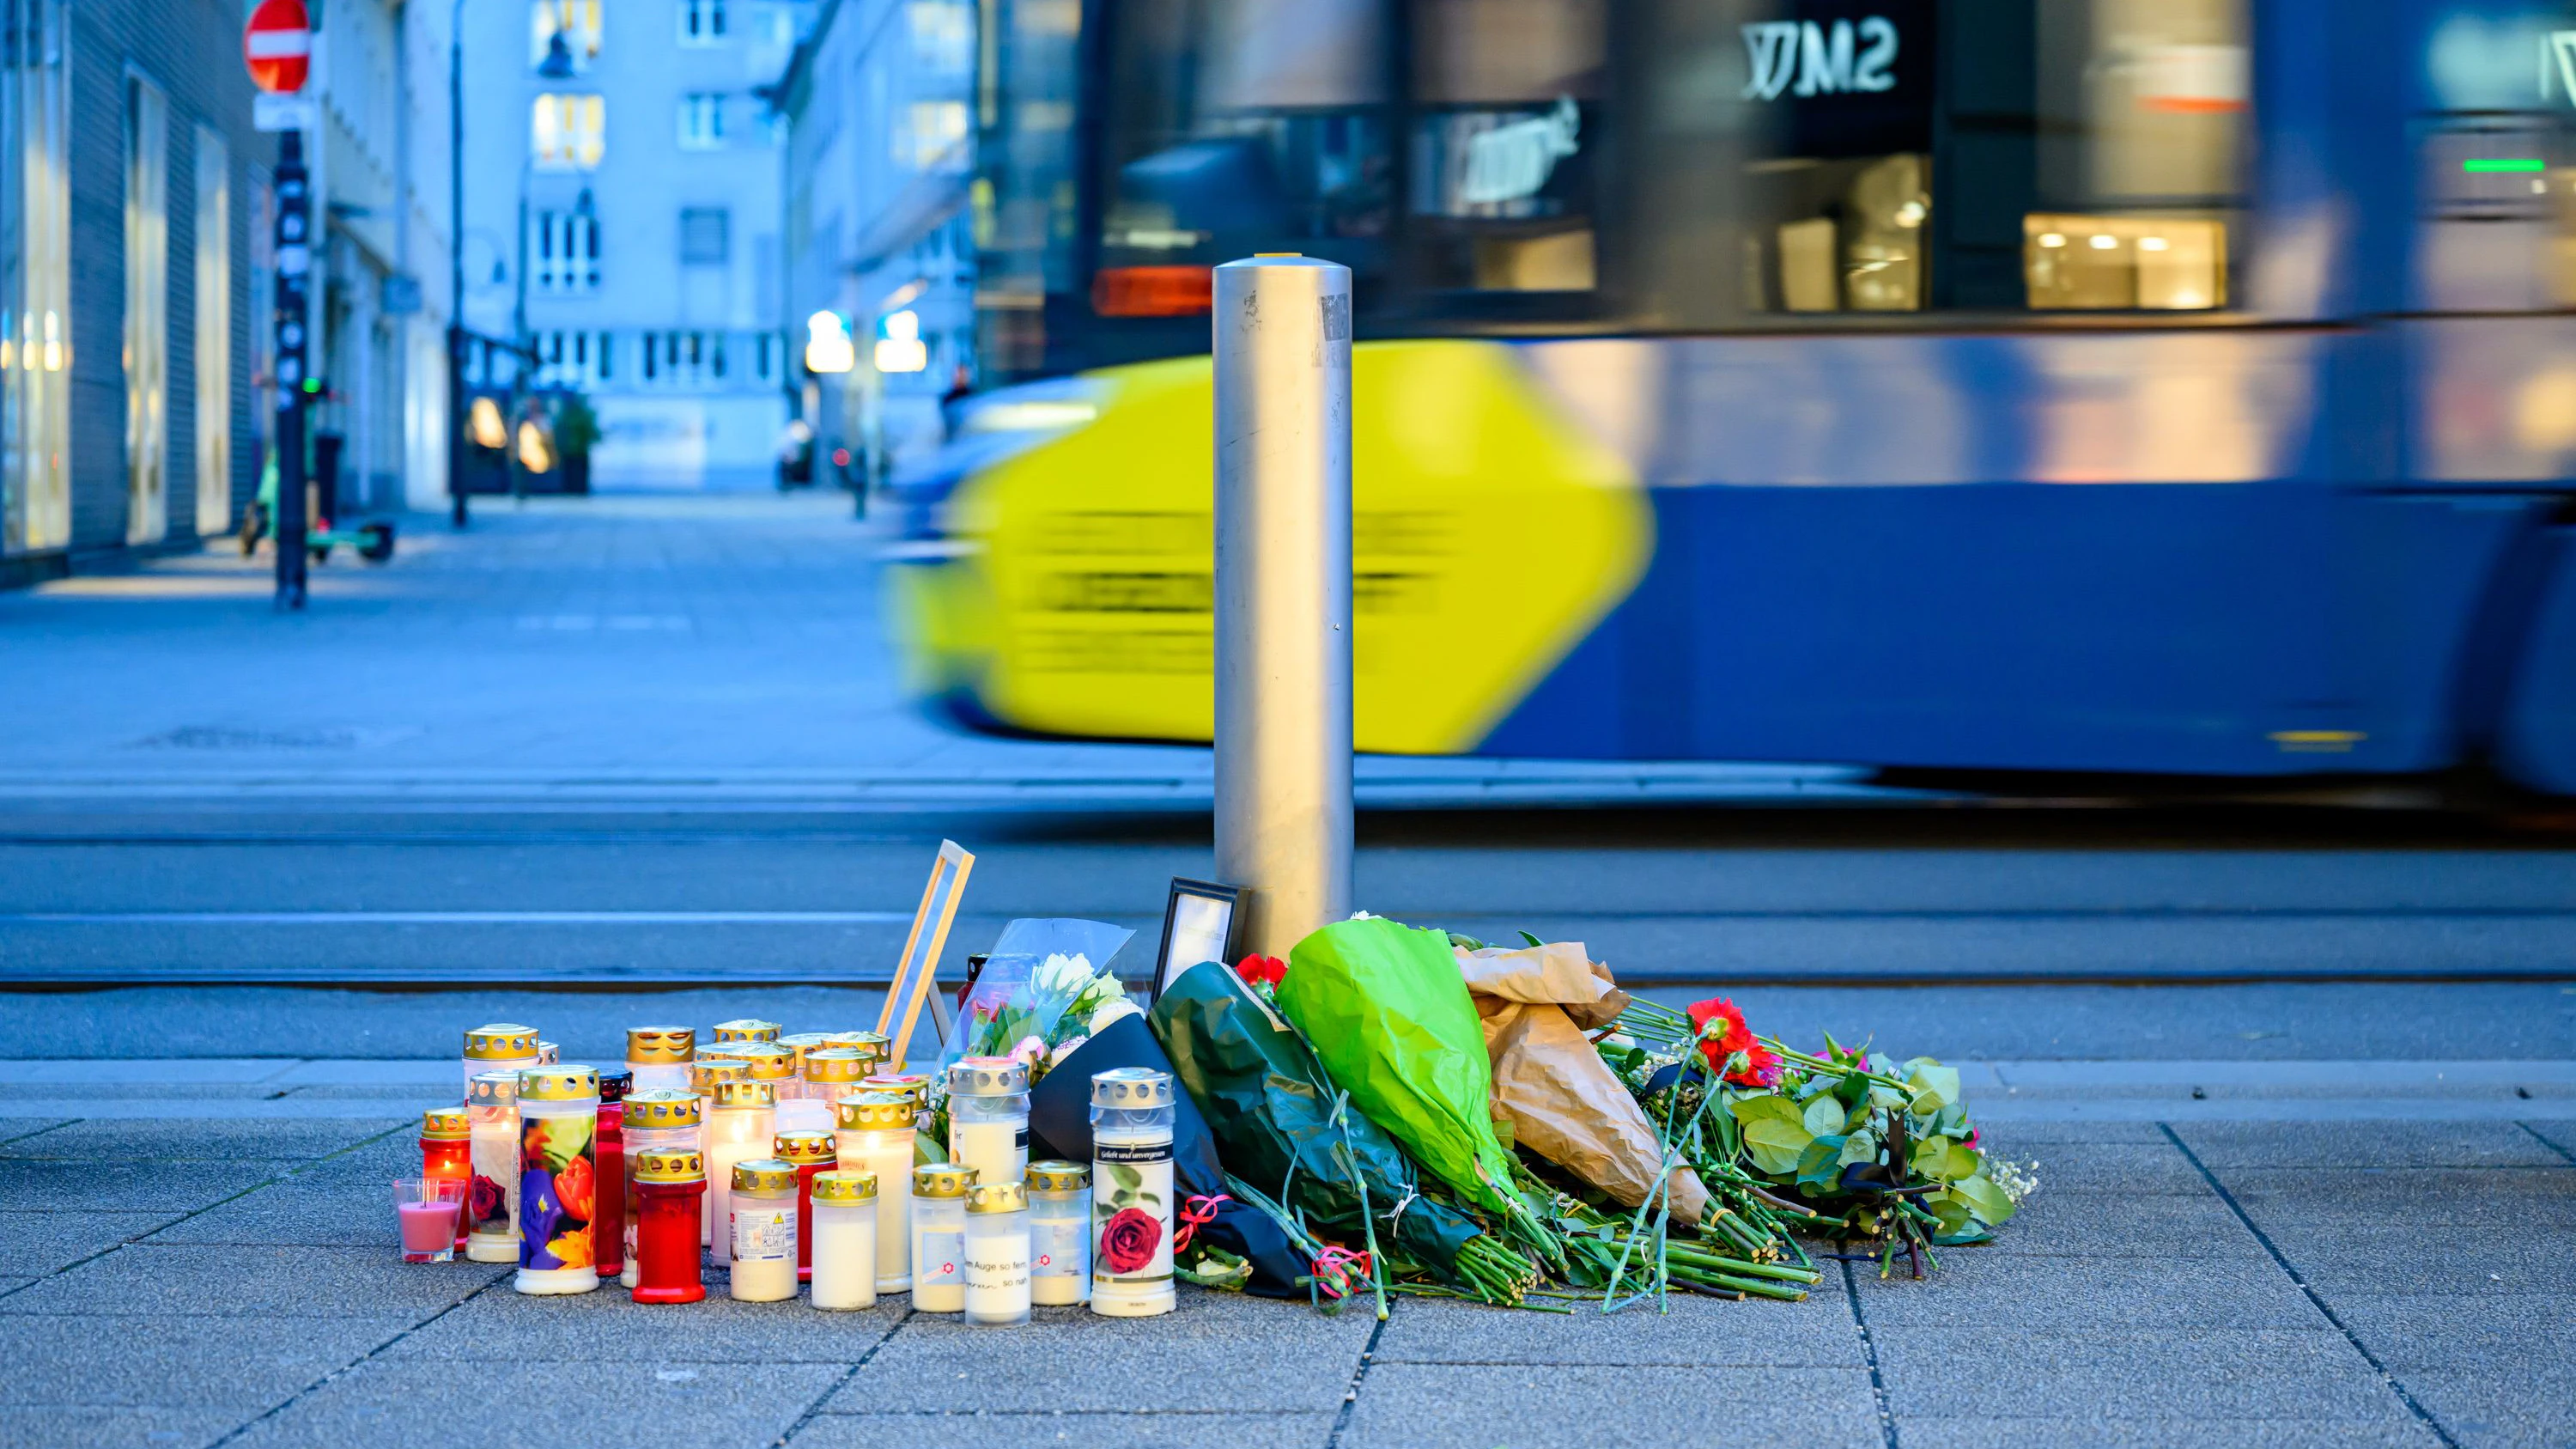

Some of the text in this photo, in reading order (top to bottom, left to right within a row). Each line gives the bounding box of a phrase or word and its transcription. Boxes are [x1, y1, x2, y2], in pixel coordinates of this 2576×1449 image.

[1119, 1151, 1132, 1160] und
[975, 1261, 996, 1272] Auge
[1003, 1279, 1013, 1288] so
